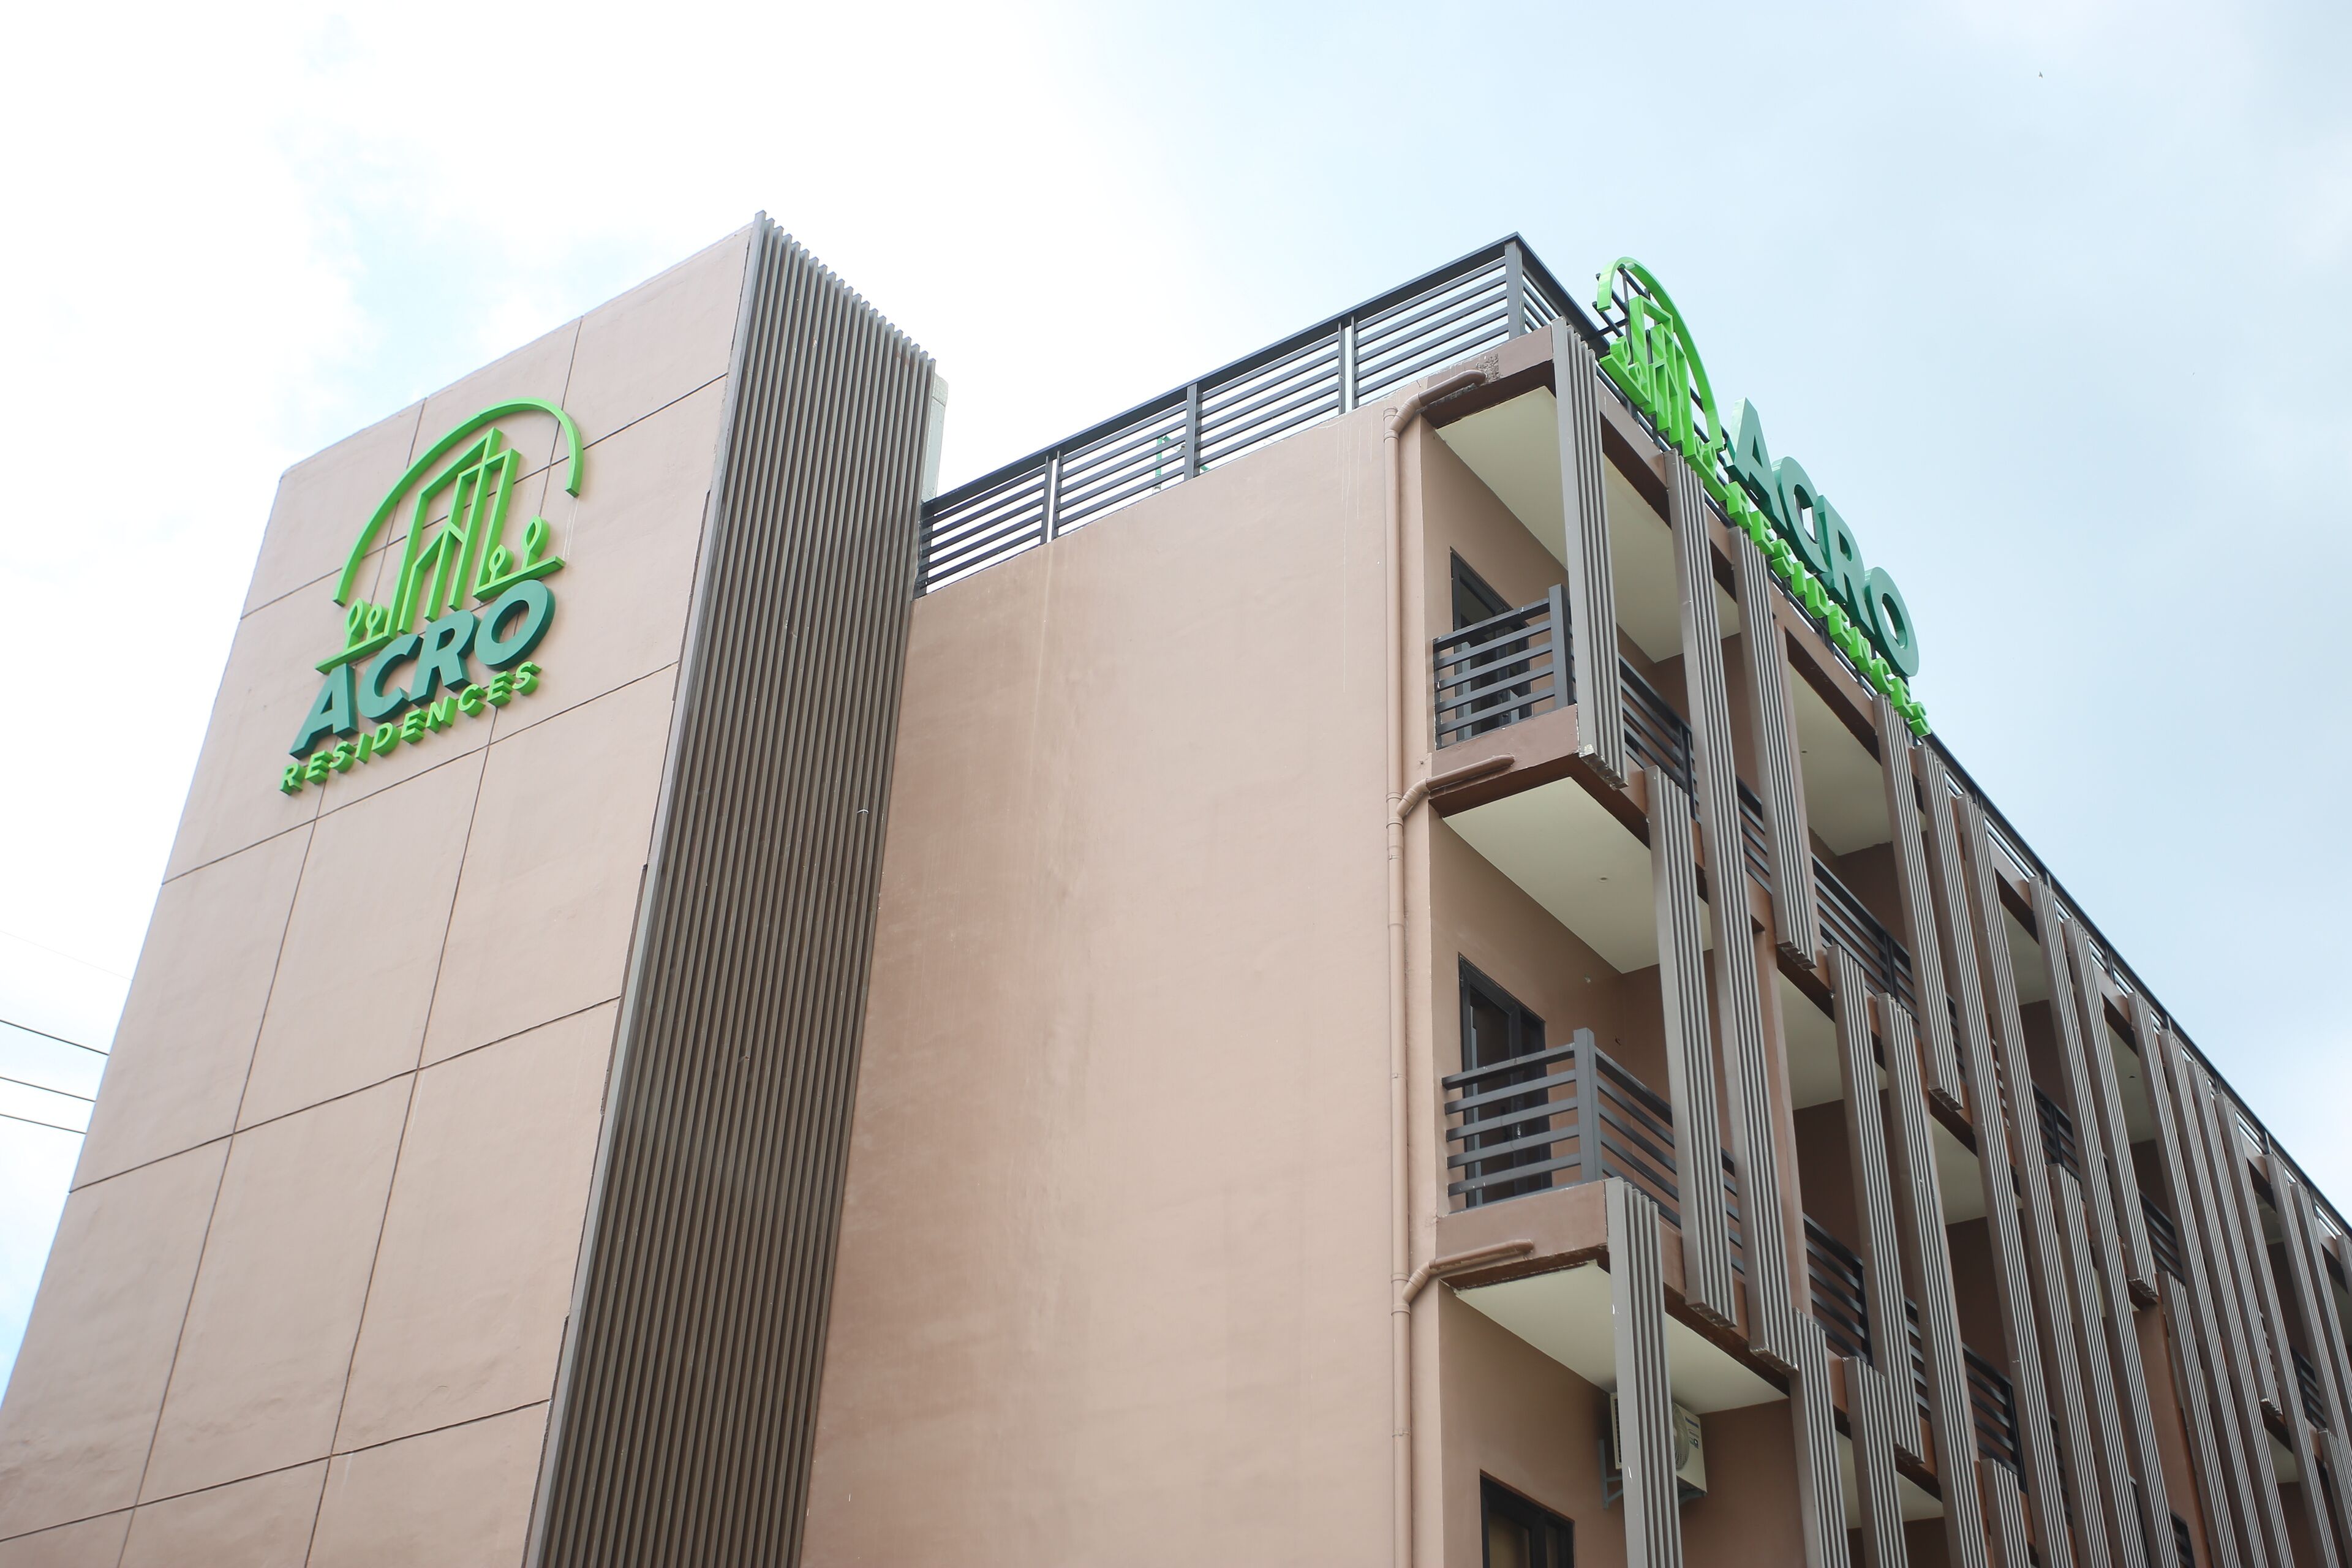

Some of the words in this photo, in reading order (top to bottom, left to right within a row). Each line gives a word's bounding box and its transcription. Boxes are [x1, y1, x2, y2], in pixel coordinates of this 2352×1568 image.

[1724, 397, 1919, 677] ACRO
[1725, 481, 1931, 737] RESIDENCES
[279, 661, 541, 795] RESIDENCES
[289, 579, 556, 761] ACRO
